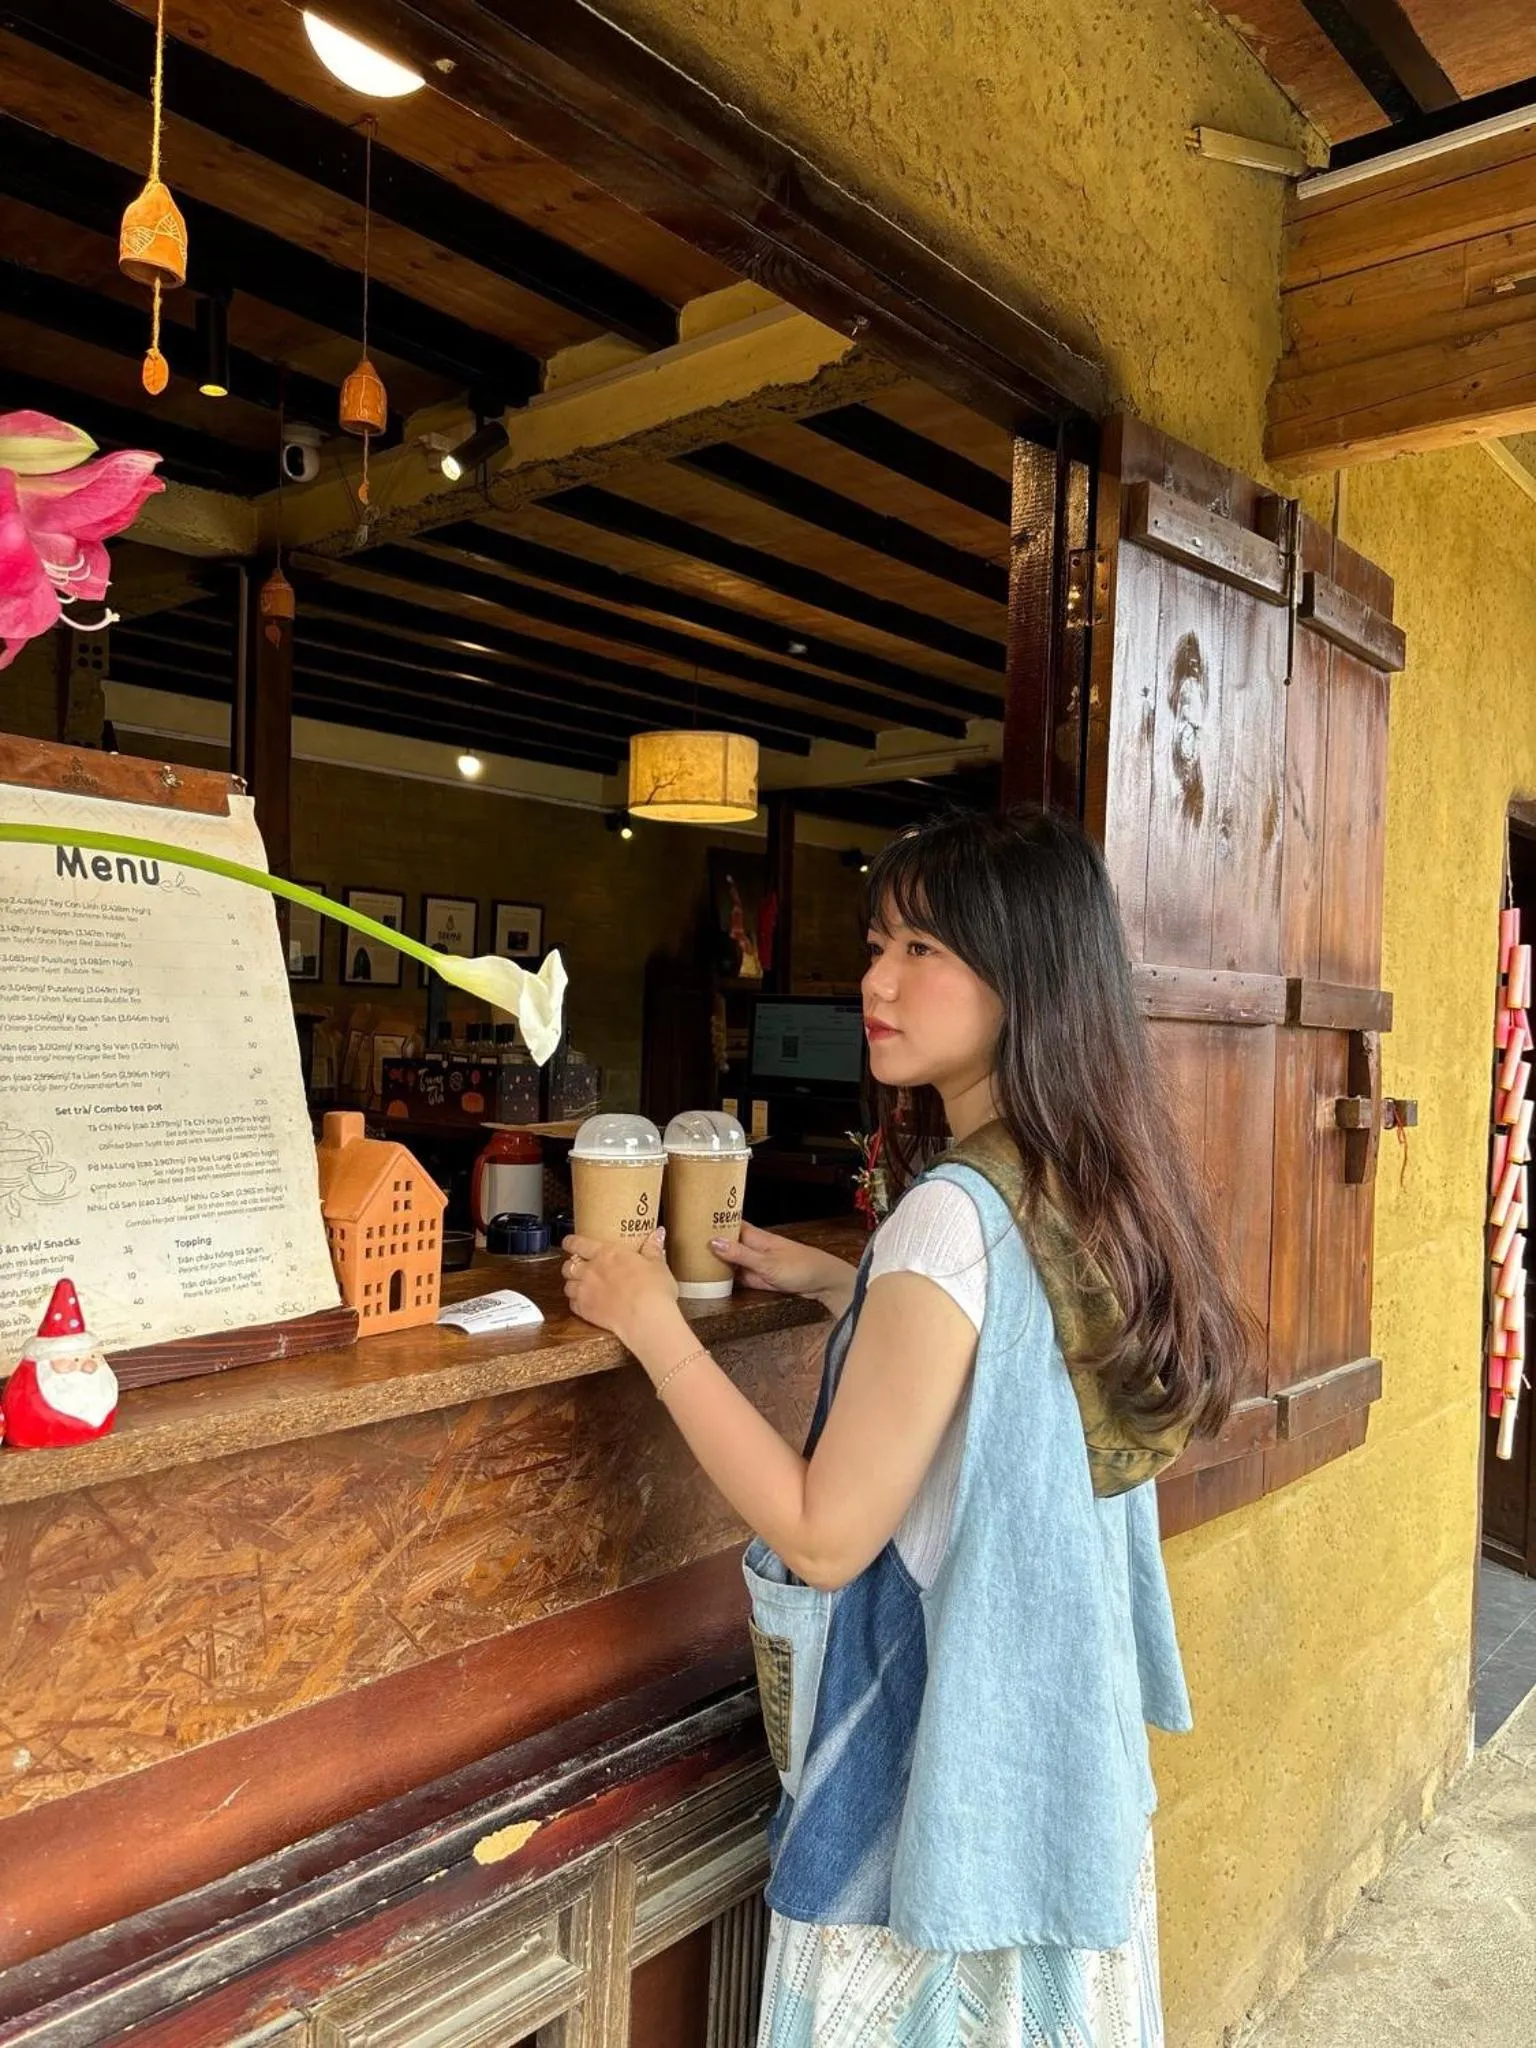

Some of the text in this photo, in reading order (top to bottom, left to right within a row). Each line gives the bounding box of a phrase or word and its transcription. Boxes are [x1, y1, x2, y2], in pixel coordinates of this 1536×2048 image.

[57, 846, 160, 885] Menu
[56, 1107, 71, 1115] Set
[94, 1105, 128, 1114] Combo
[130, 1104, 144, 1113] tea
[147, 1103, 163, 1112] pot
[44, 1237, 81, 1249] Snacks
[175, 1236, 212, 1248] Topping
